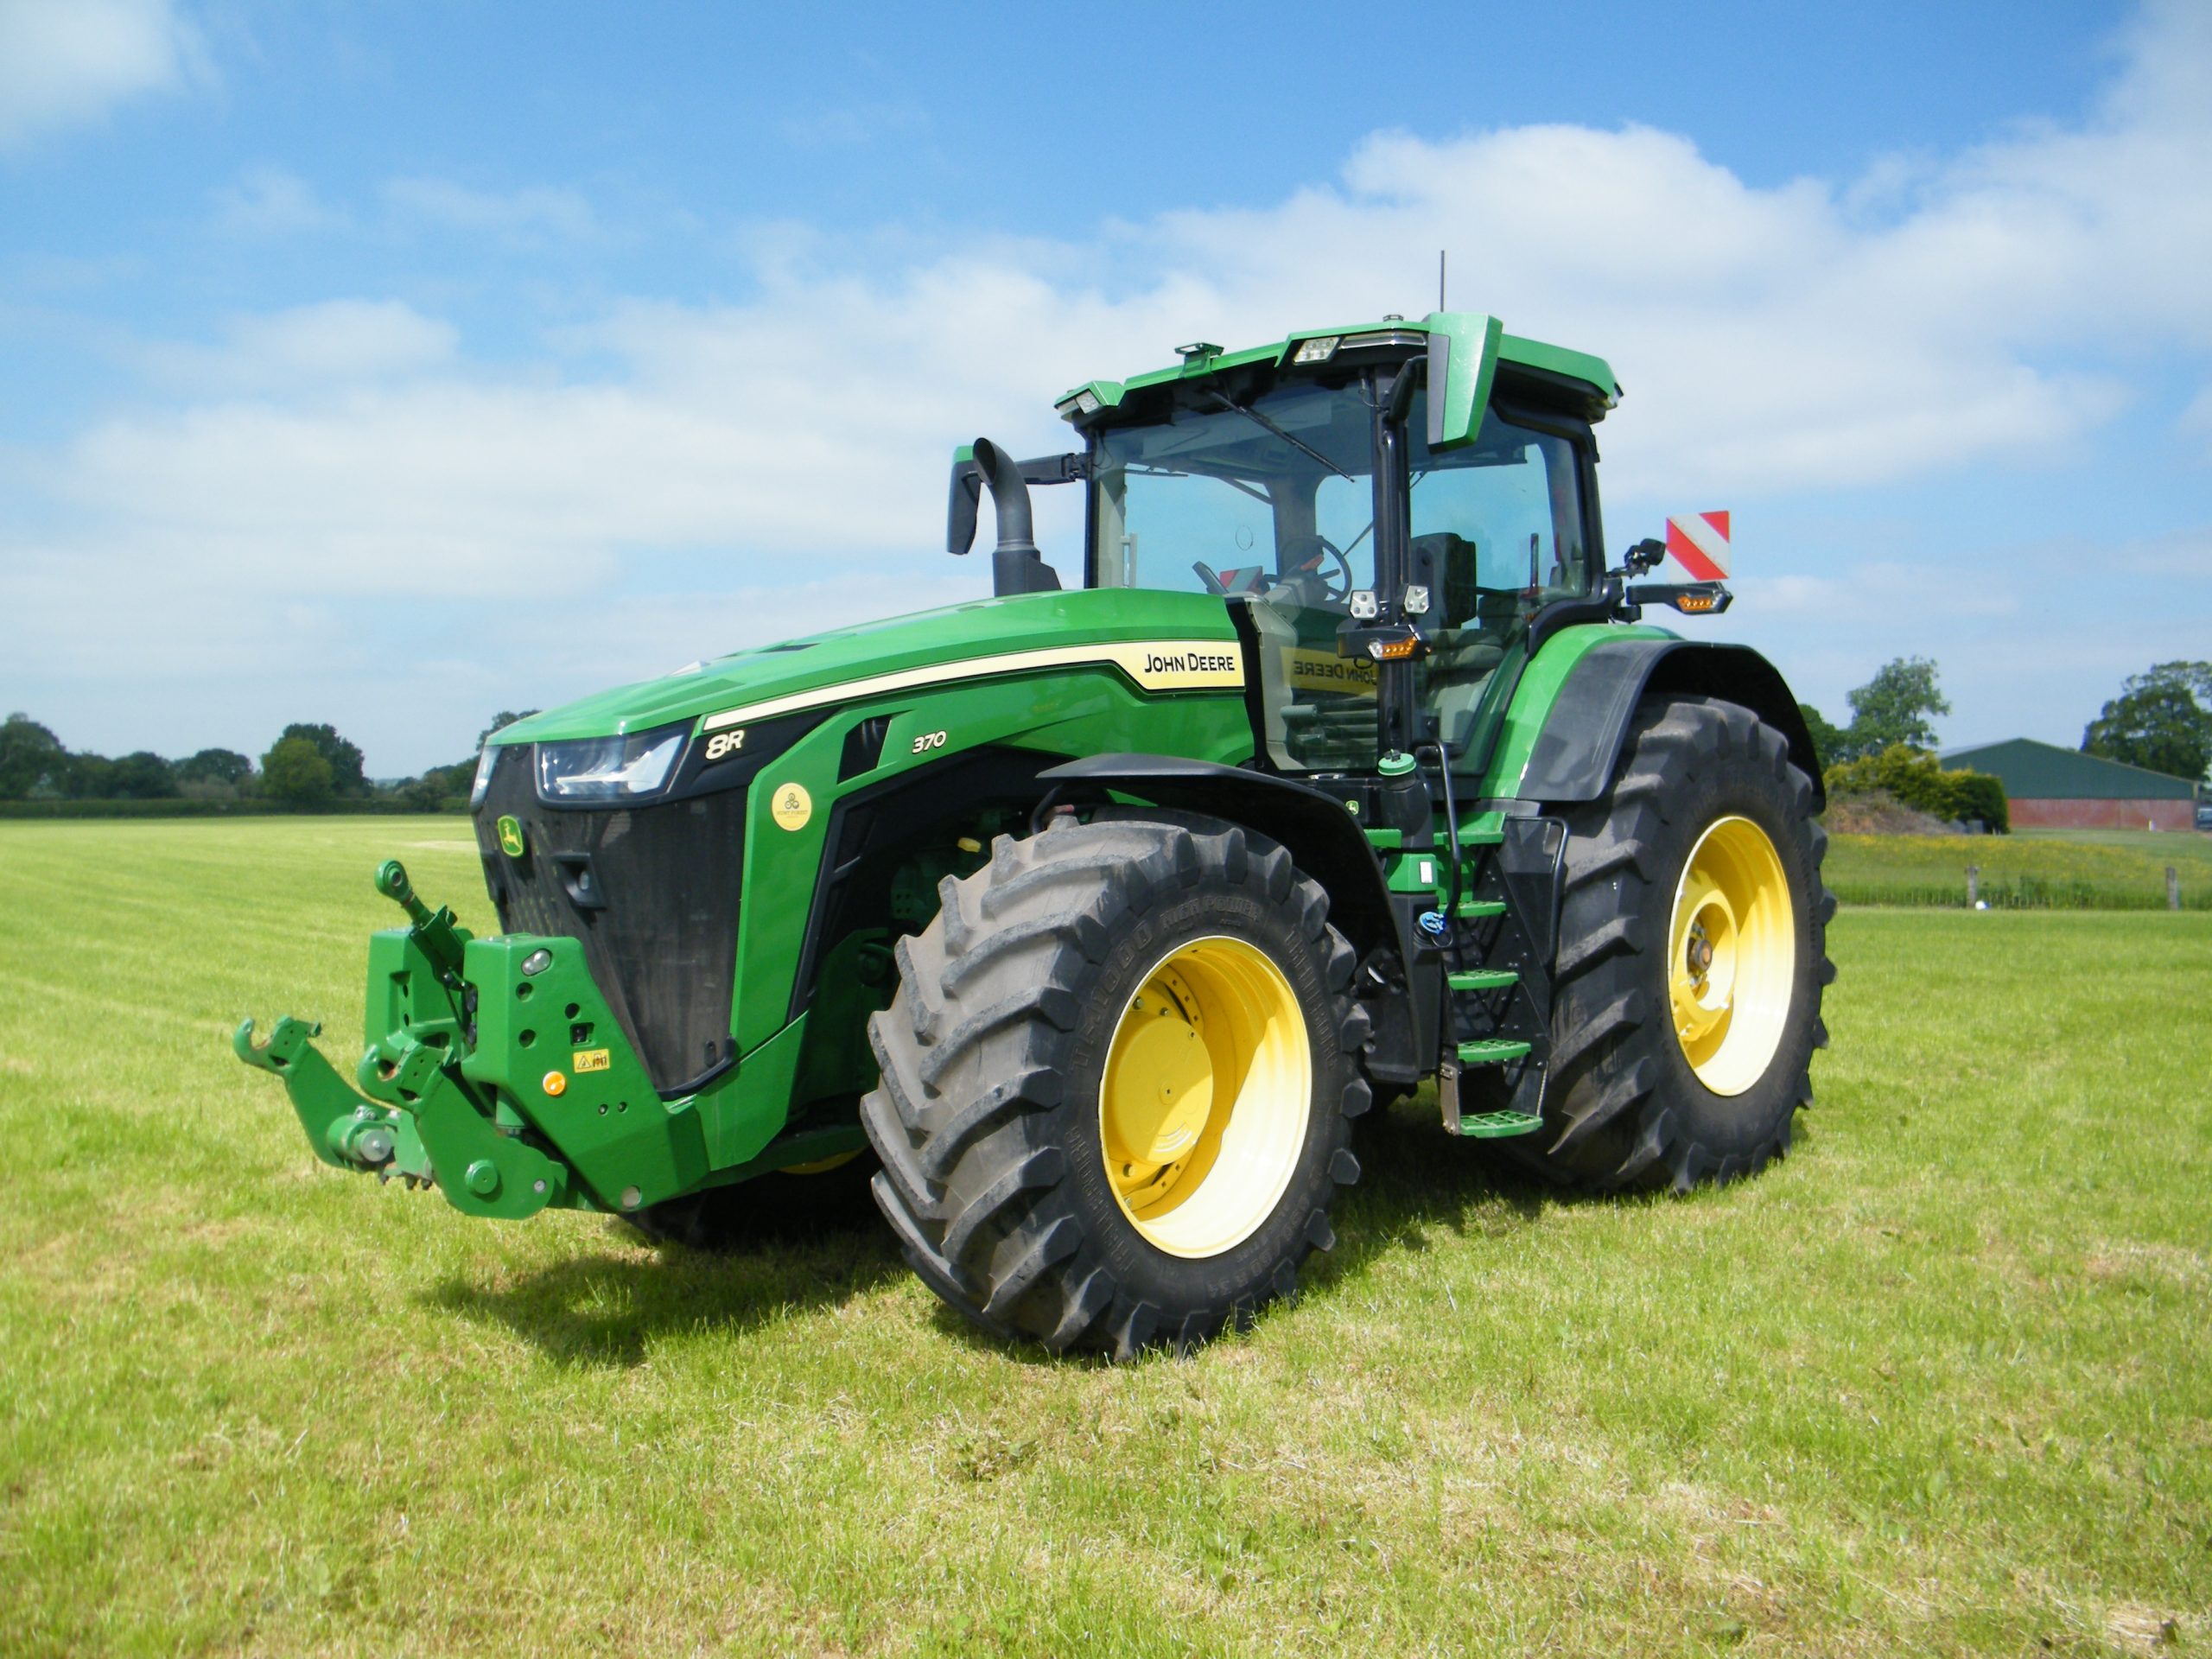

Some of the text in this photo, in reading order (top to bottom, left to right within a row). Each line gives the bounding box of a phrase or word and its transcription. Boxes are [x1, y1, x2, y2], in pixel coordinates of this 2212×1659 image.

[1144, 653, 1236, 674] JOHN DEERE
[705, 729, 746, 760] 8R
[911, 730, 946, 754] 370
